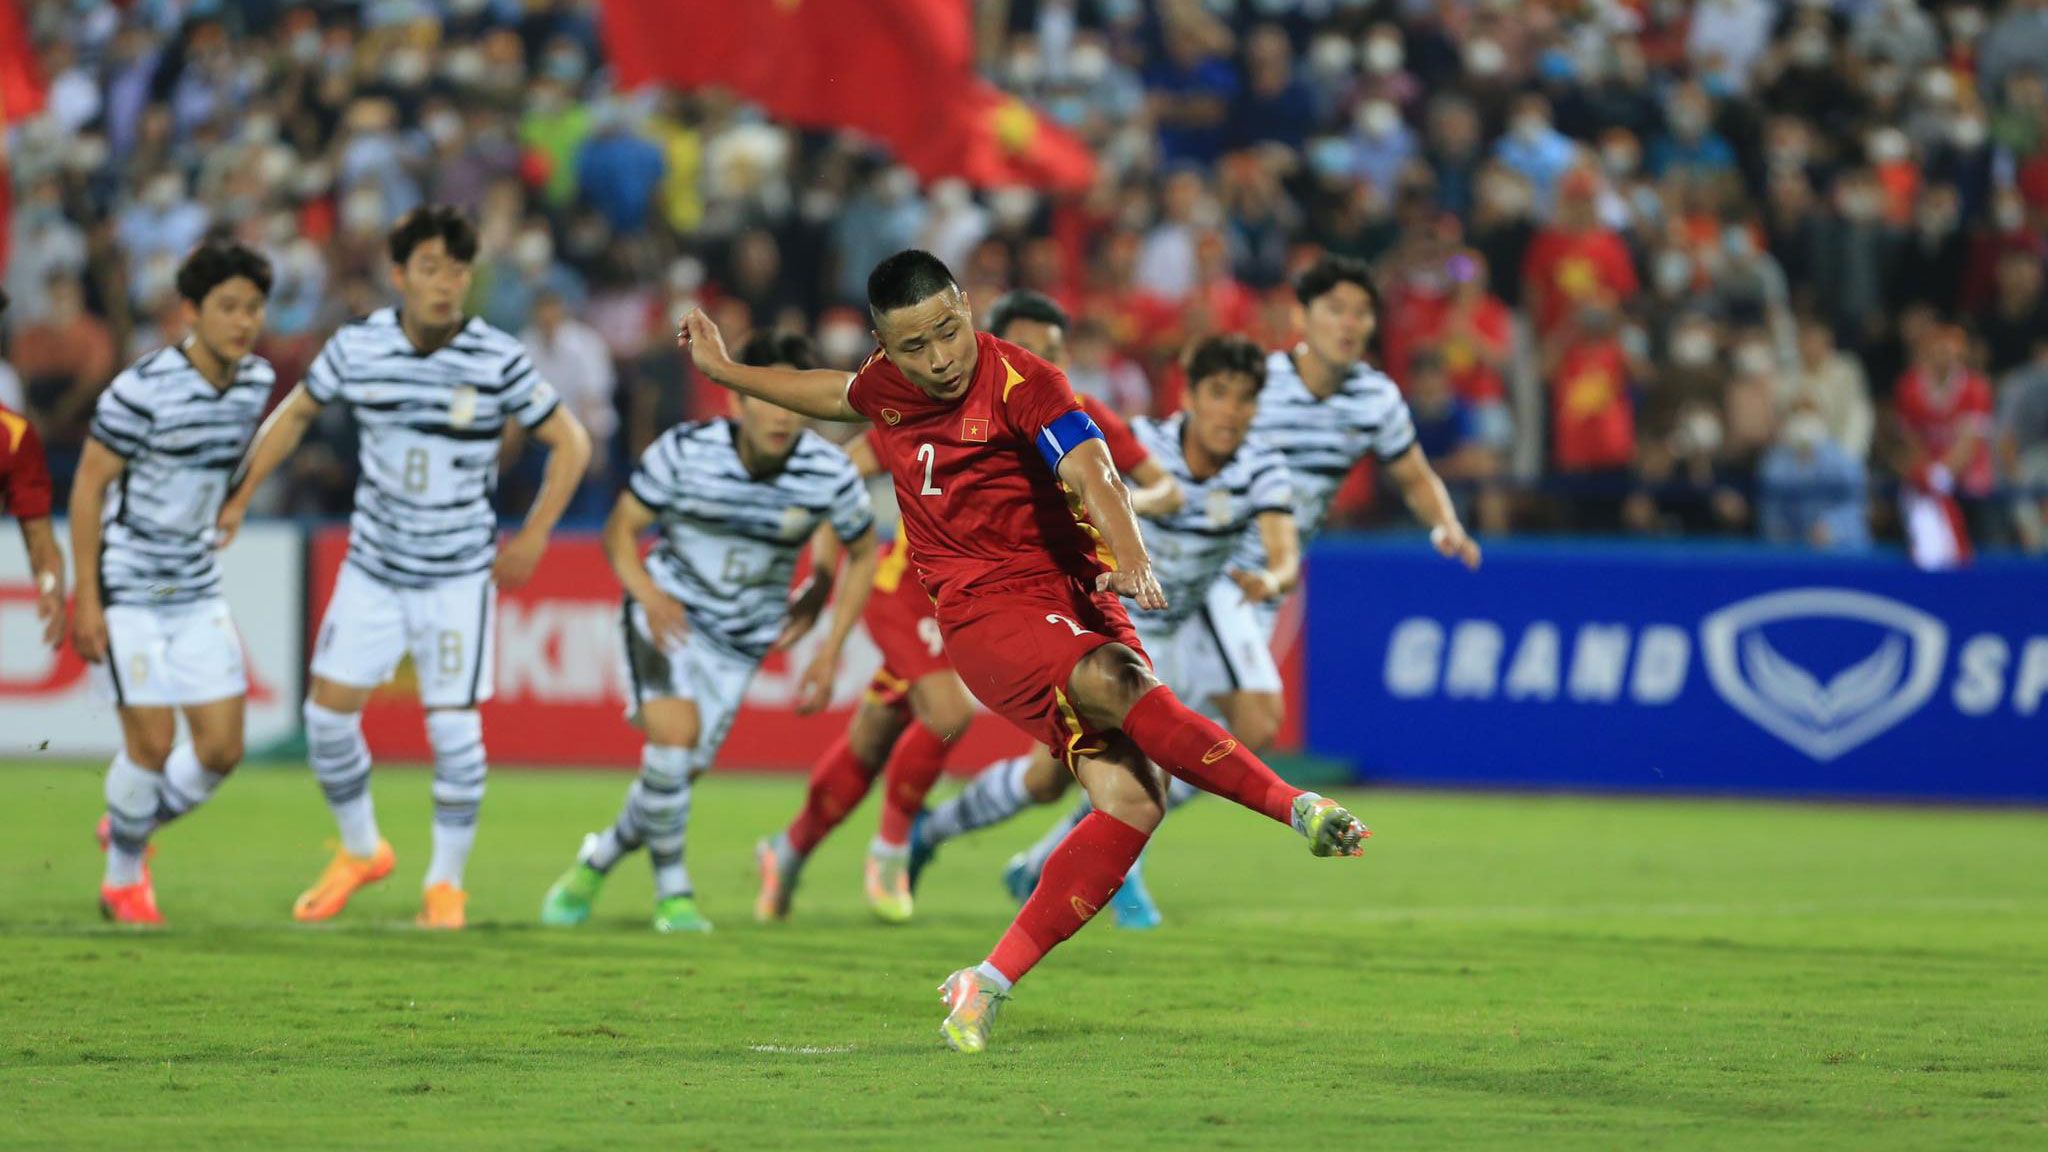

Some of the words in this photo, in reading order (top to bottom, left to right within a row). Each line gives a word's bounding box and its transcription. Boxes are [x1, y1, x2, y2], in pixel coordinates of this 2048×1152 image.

[404, 447, 429, 495] 8
[917, 443, 943, 496] 2
[916, 617, 944, 657] 9
[1045, 613, 1095, 637] 2
[437, 629, 464, 676] 8
[1384, 617, 1692, 704] GRAND
